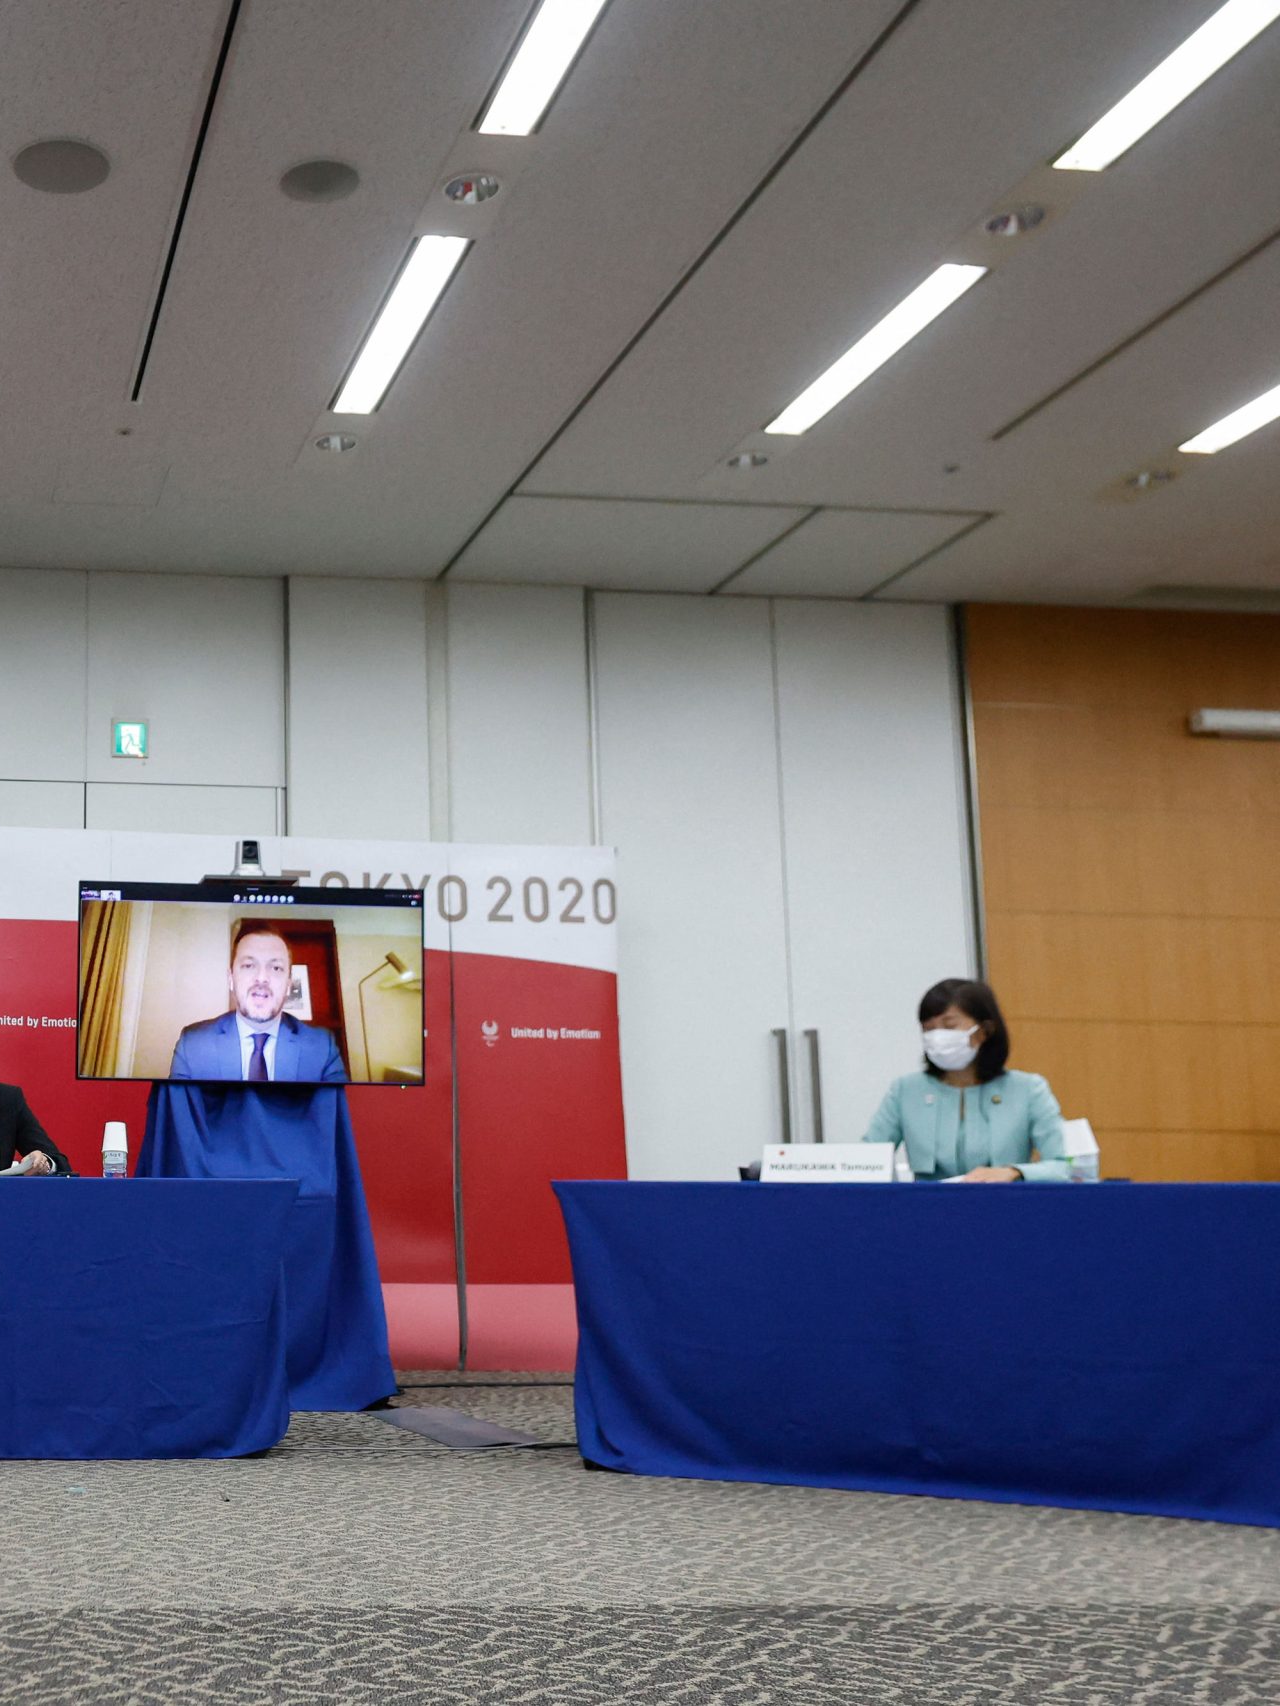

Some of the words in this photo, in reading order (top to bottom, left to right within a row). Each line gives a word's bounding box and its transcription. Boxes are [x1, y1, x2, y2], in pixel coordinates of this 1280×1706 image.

[486, 875, 617, 925] 2020
[27, 1016, 39, 1028] by
[41, 1016, 77, 1028] Emotio
[511, 1027, 545, 1039] United
[547, 1027, 559, 1040] by
[560, 1028, 601, 1040] Emotion
